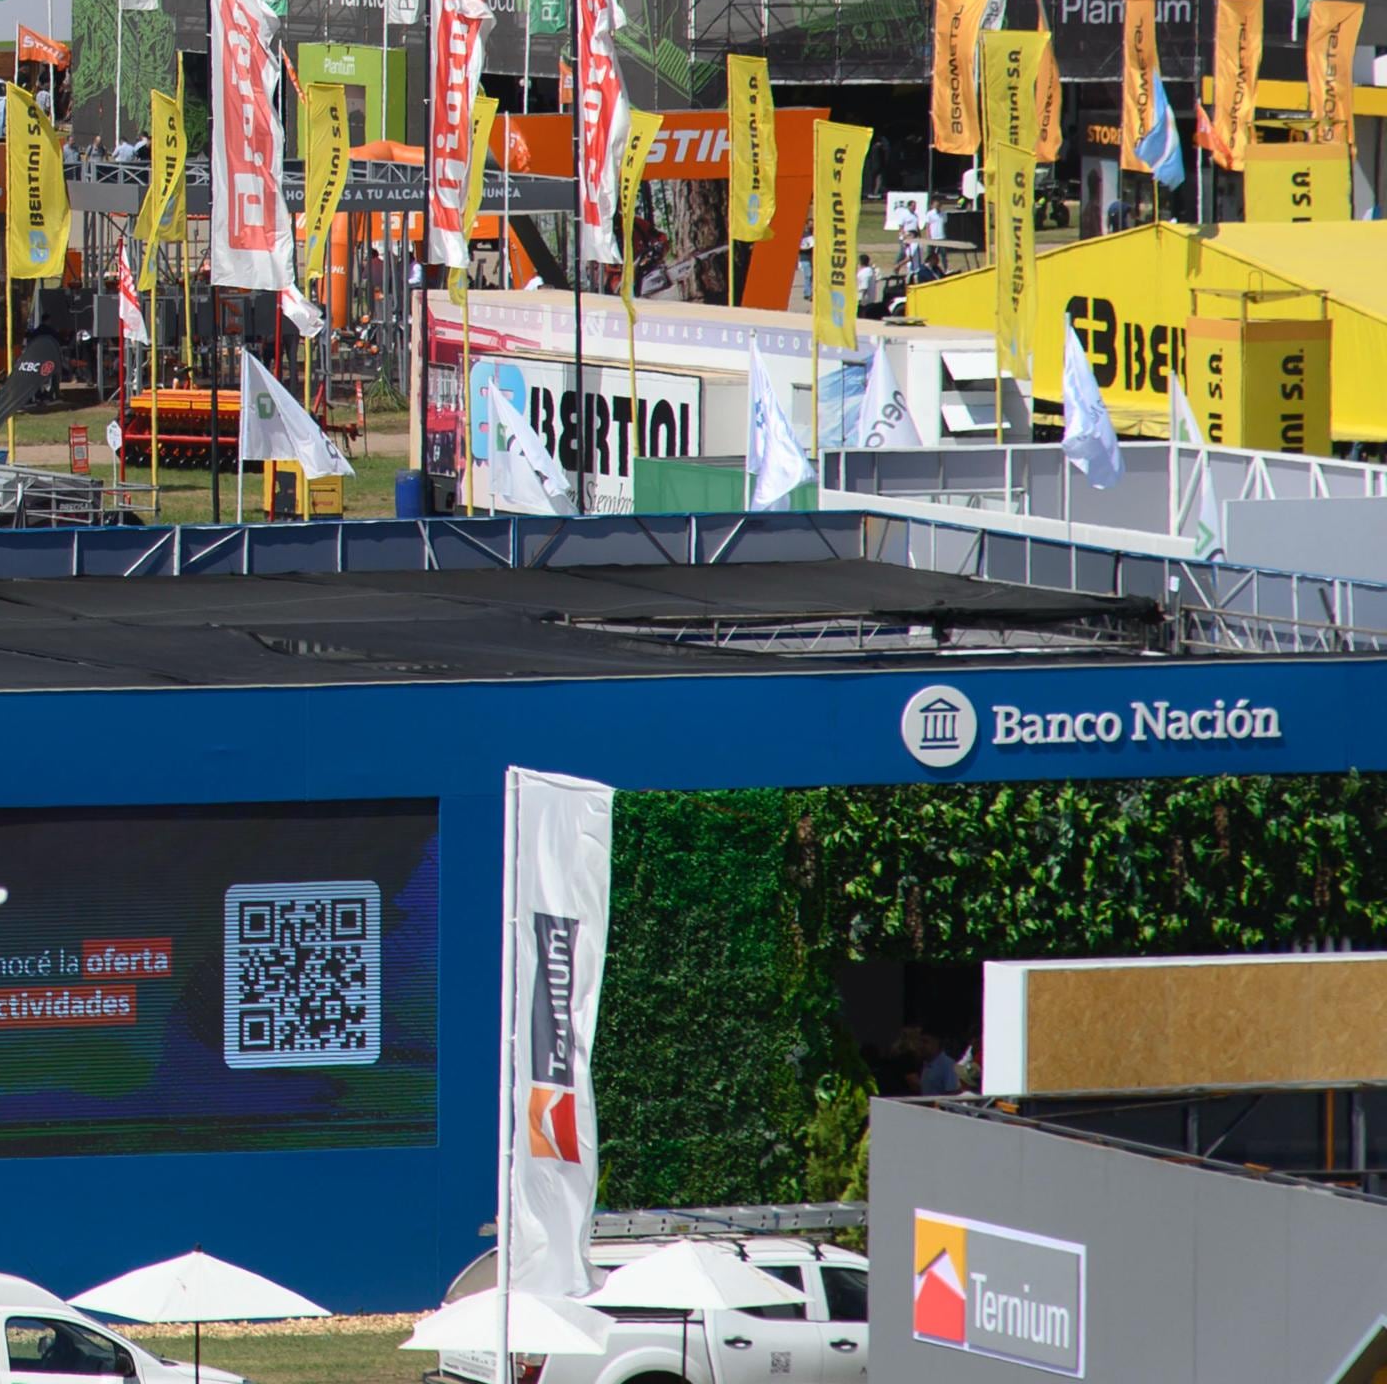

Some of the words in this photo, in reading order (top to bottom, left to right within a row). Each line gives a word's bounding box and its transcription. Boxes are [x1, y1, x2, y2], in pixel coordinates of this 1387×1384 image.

[323, 56, 356, 76] Plantium
[646, 128, 730, 164] STIH
[27, 143, 45, 228] BERTINI
[358, 189, 366, 199] A
[367, 188, 383, 200] TU
[384, 187, 426, 200] ALCAN
[831, 192, 848, 287] BERTINI
[18, 361, 40, 373] ICBC
[991, 704, 1122, 746] Banco
[1130, 699, 1283, 742] Nación
[58, 948, 79, 976] la
[85, 946, 170, 975] oferta
[970, 1272, 1072, 1349] Ternium
